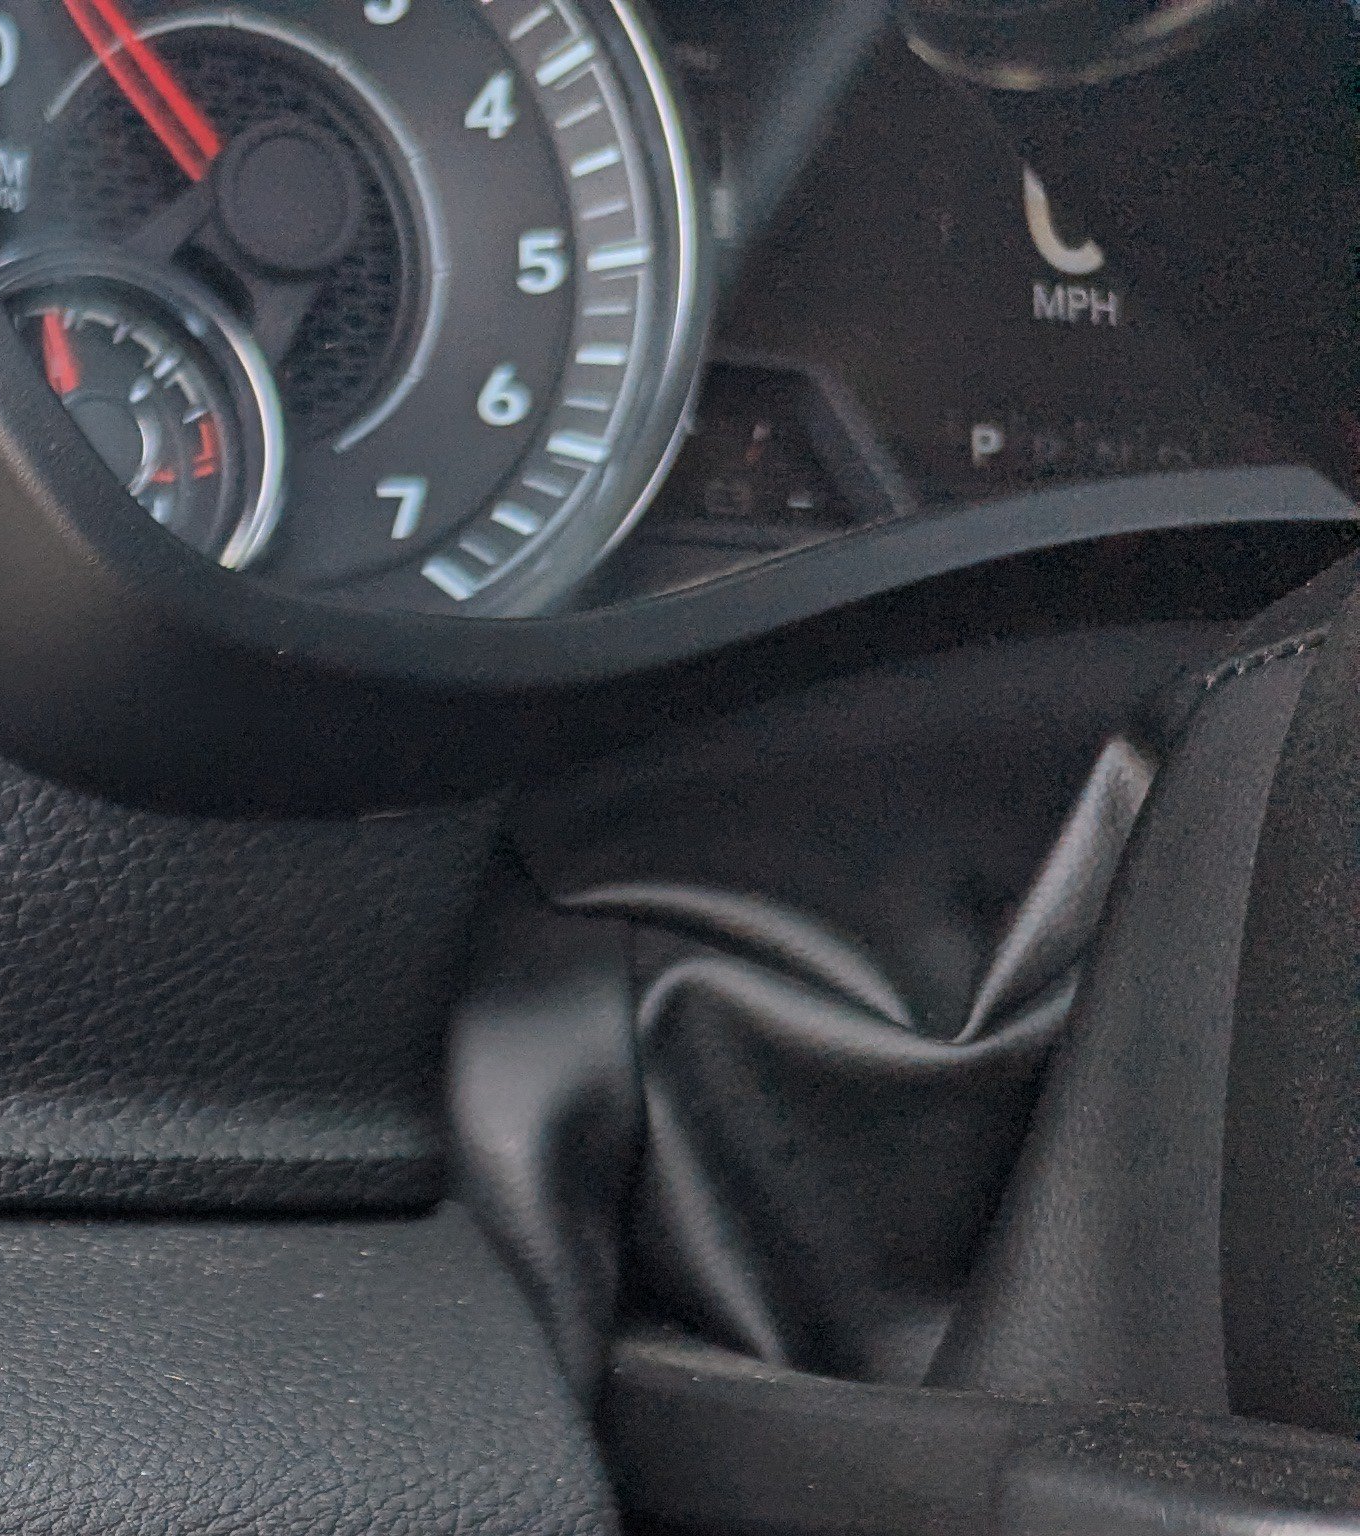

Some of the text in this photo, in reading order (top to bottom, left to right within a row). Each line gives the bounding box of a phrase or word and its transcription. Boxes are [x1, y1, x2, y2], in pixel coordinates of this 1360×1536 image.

[464, 71, 516, 139] 4
[516, 229, 565, 295] 5
[1032, 283, 1117, 327] MPH
[477, 363, 528, 426] 6
[972, 422, 1004, 467] P
[376, 475, 426, 539] 7
